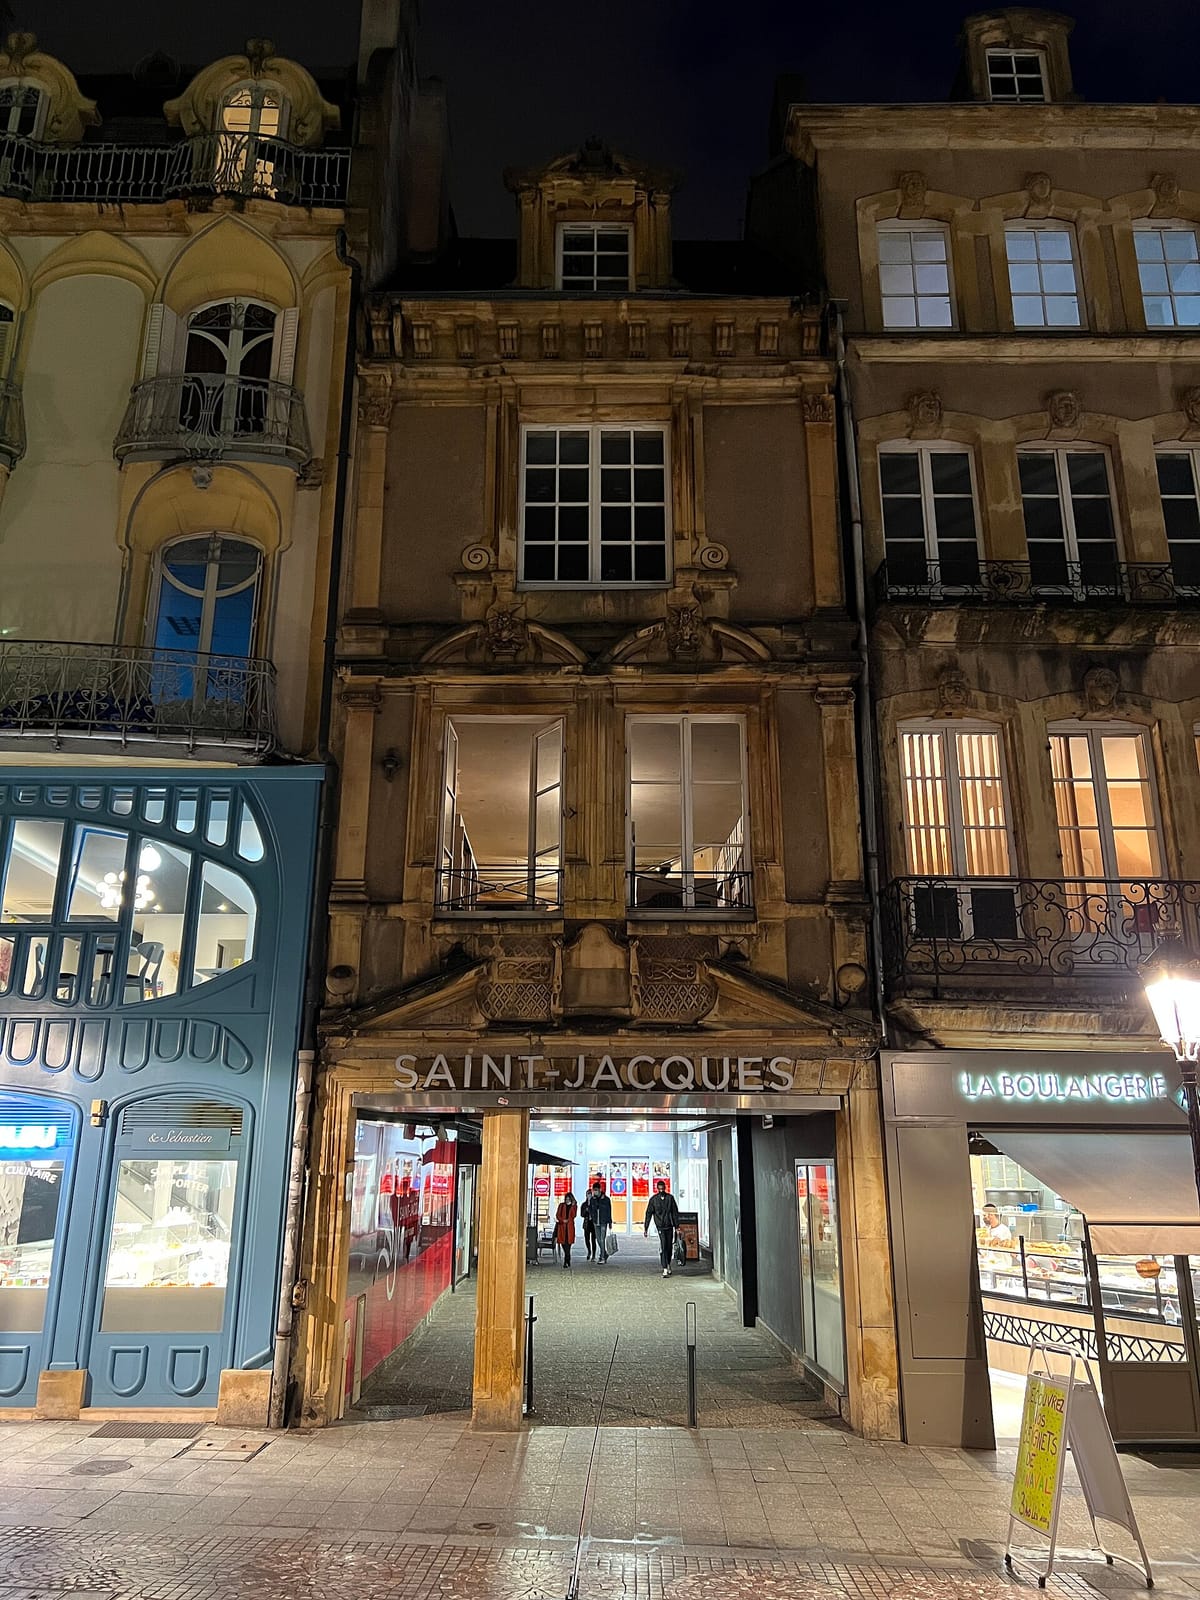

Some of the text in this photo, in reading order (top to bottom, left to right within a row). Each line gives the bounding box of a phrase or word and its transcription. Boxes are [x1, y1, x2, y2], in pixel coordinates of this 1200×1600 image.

[394, 1054, 794, 1090] SAINT-JACQUES
[964, 1073, 1167, 1098] LA BOULANGERIE
[5, 1165, 58, 1184] CULINAIRE
